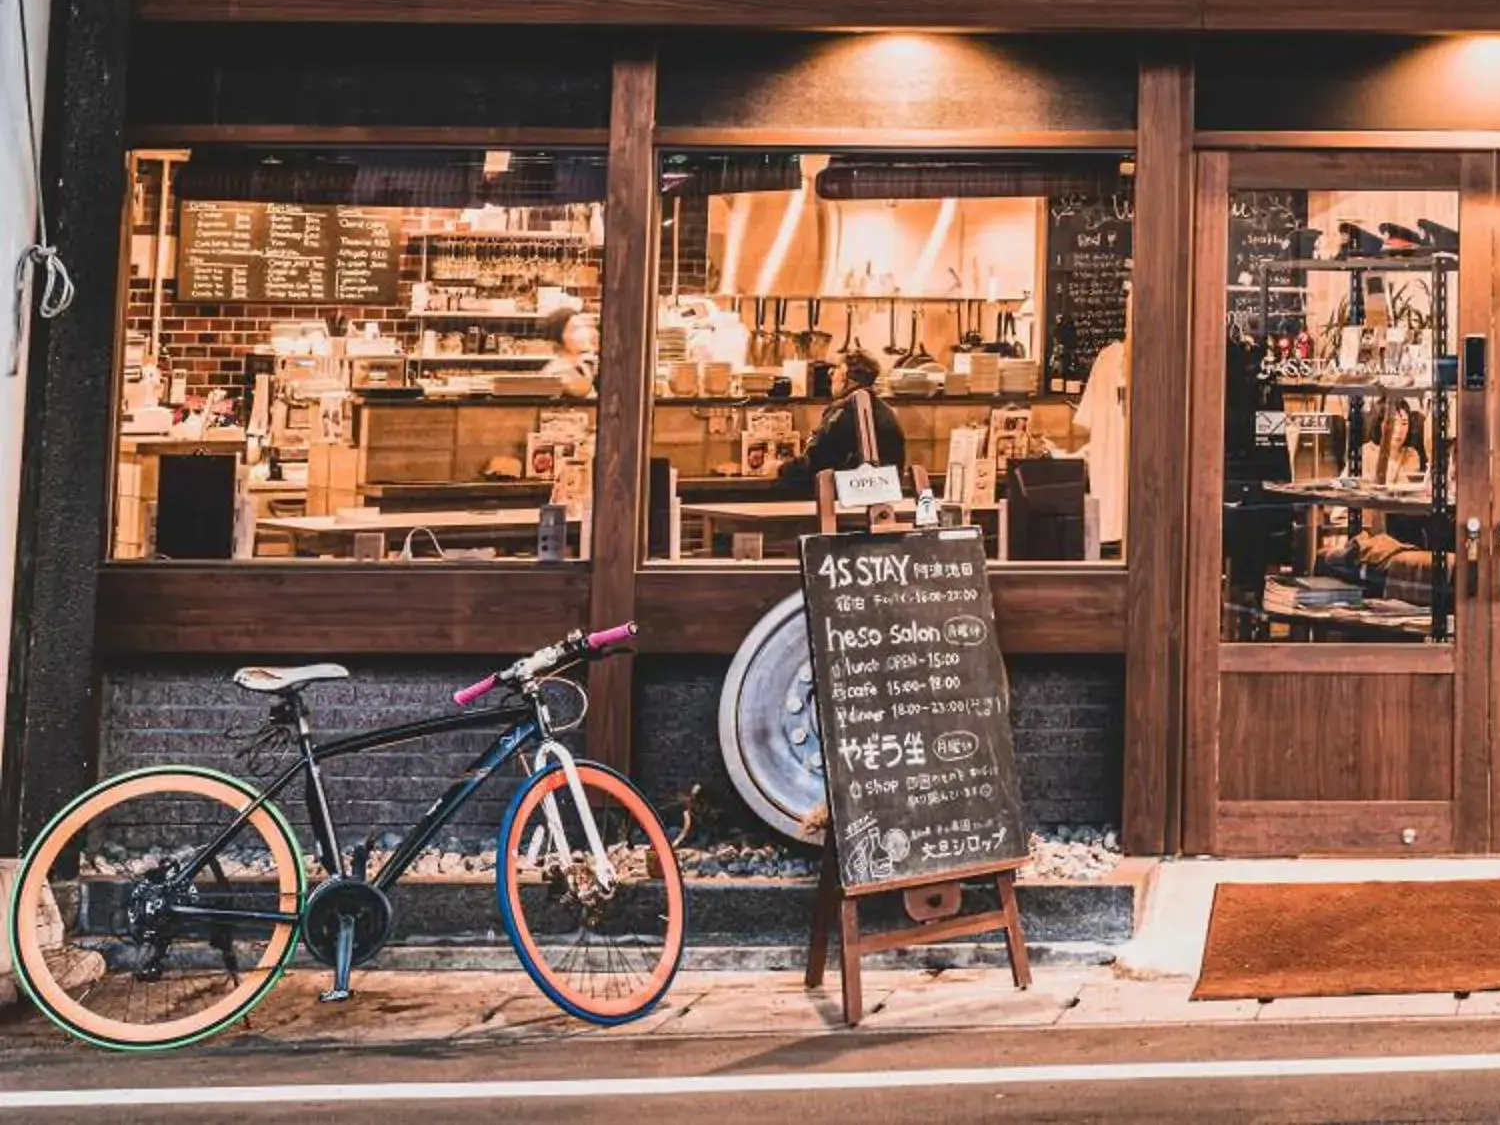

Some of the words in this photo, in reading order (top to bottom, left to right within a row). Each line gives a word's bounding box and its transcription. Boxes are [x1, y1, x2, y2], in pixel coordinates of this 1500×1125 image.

[849, 475, 889, 489] OPEN
[856, 554, 910, 586] STAY
[825, 616, 883, 652] heso
[890, 620, 941, 645] salon
[845, 657, 881, 676] lunch
[865, 778, 900, 794] shop
